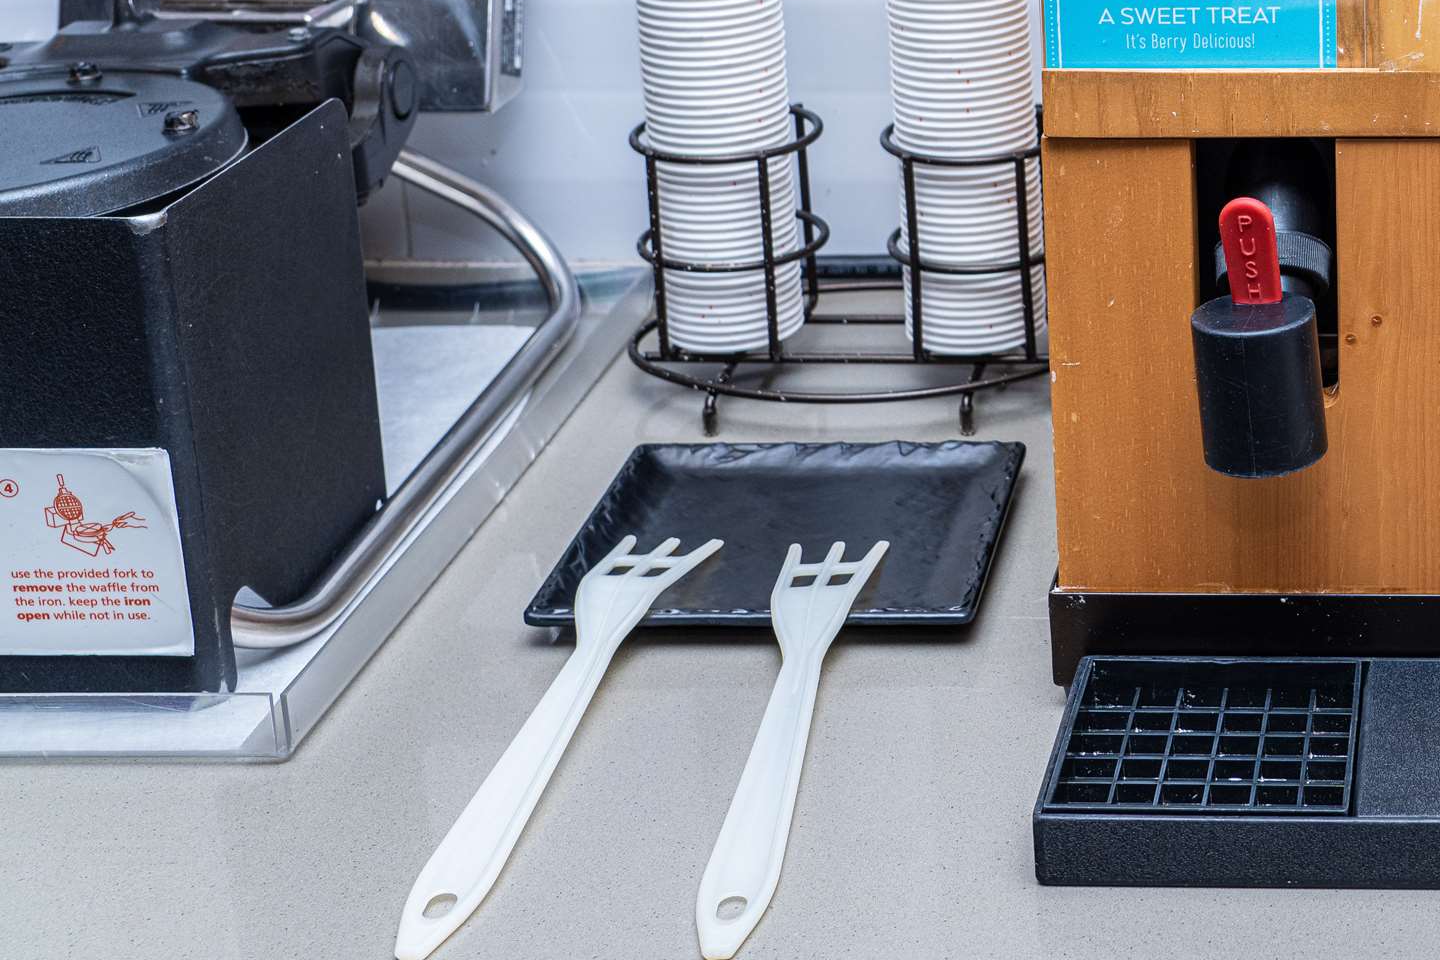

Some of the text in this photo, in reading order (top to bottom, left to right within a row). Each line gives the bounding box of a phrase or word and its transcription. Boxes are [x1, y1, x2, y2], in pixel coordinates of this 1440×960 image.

[1098, 6, 1281, 25] A SWEET TREAT
[1126, 34, 1255, 53] It's Berry Delicious!
[1238, 214, 1262, 301] PUSH
[4, 483, 13, 493] 4
[11, 568, 154, 581] use the provided fork to
[13, 582, 160, 593] remove the waffle from
[15, 596, 151, 609] the iron. keep the iron
[17, 610, 151, 622] open while not in use.
